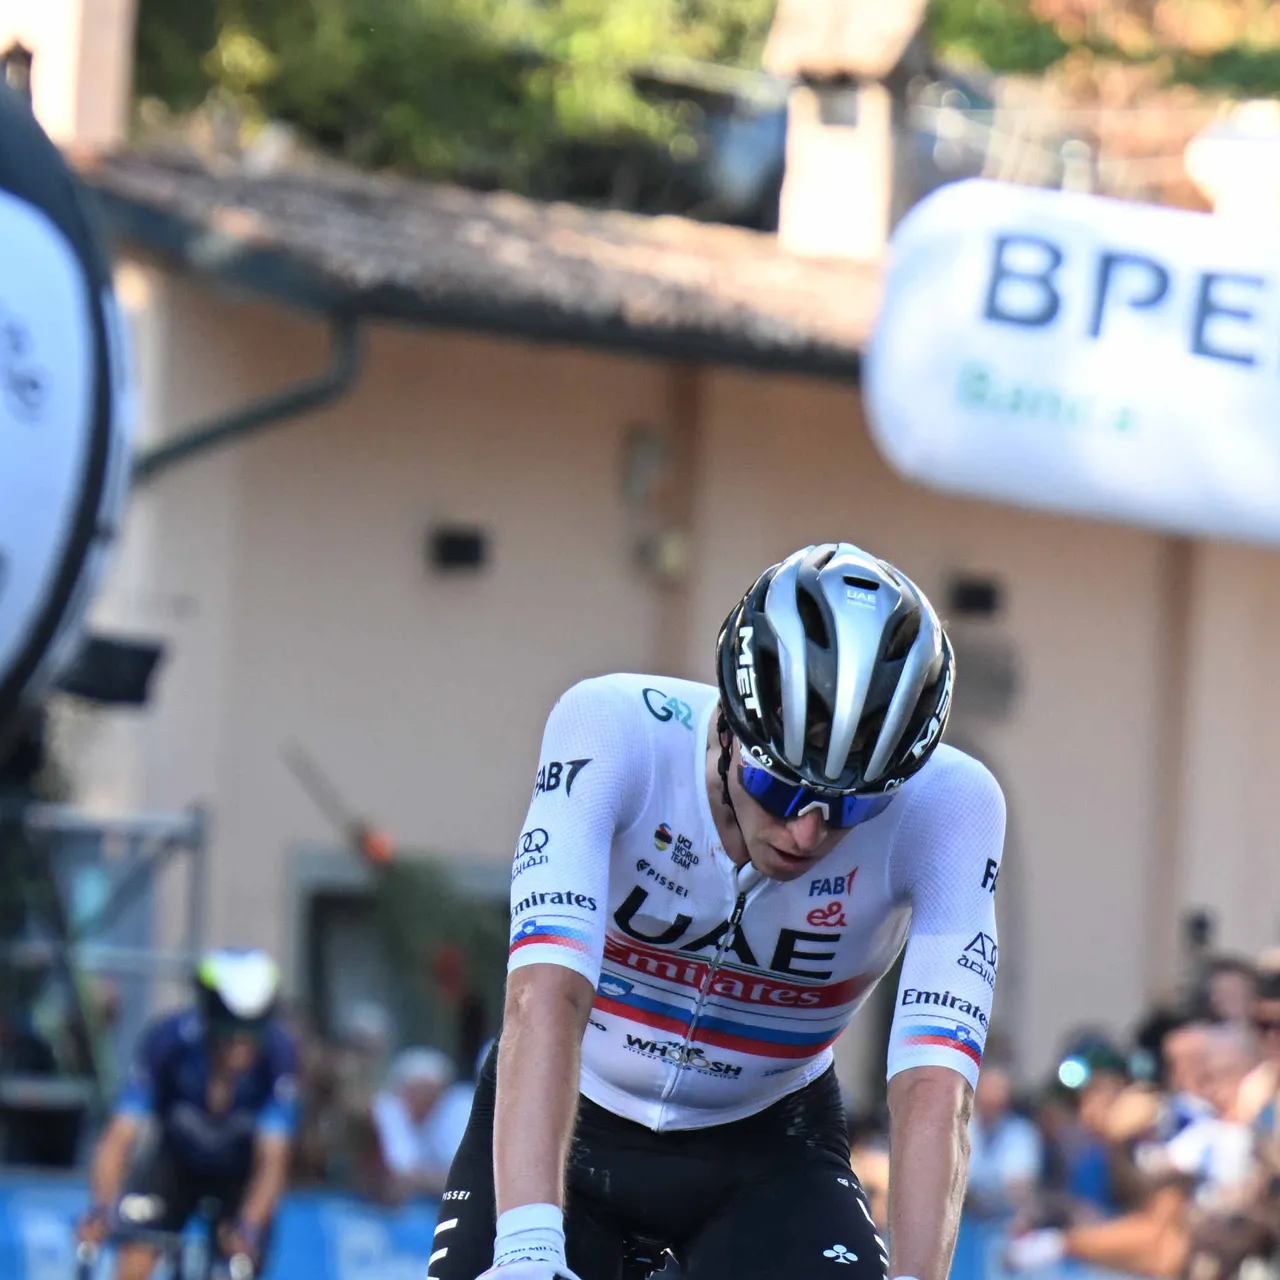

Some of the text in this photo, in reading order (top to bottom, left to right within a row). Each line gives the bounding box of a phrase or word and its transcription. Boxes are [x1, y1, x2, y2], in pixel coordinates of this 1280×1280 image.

[735, 625, 762, 719] MET
[642, 688, 693, 731] G42
[674, 843, 700, 865] WORLD
[676, 834, 693, 850] UCI
[670, 852, 692, 870] TEAM
[646, 867, 689, 898] PISSEI
[512, 889, 598, 917] mirates
[613, 884, 841, 981] UAE
